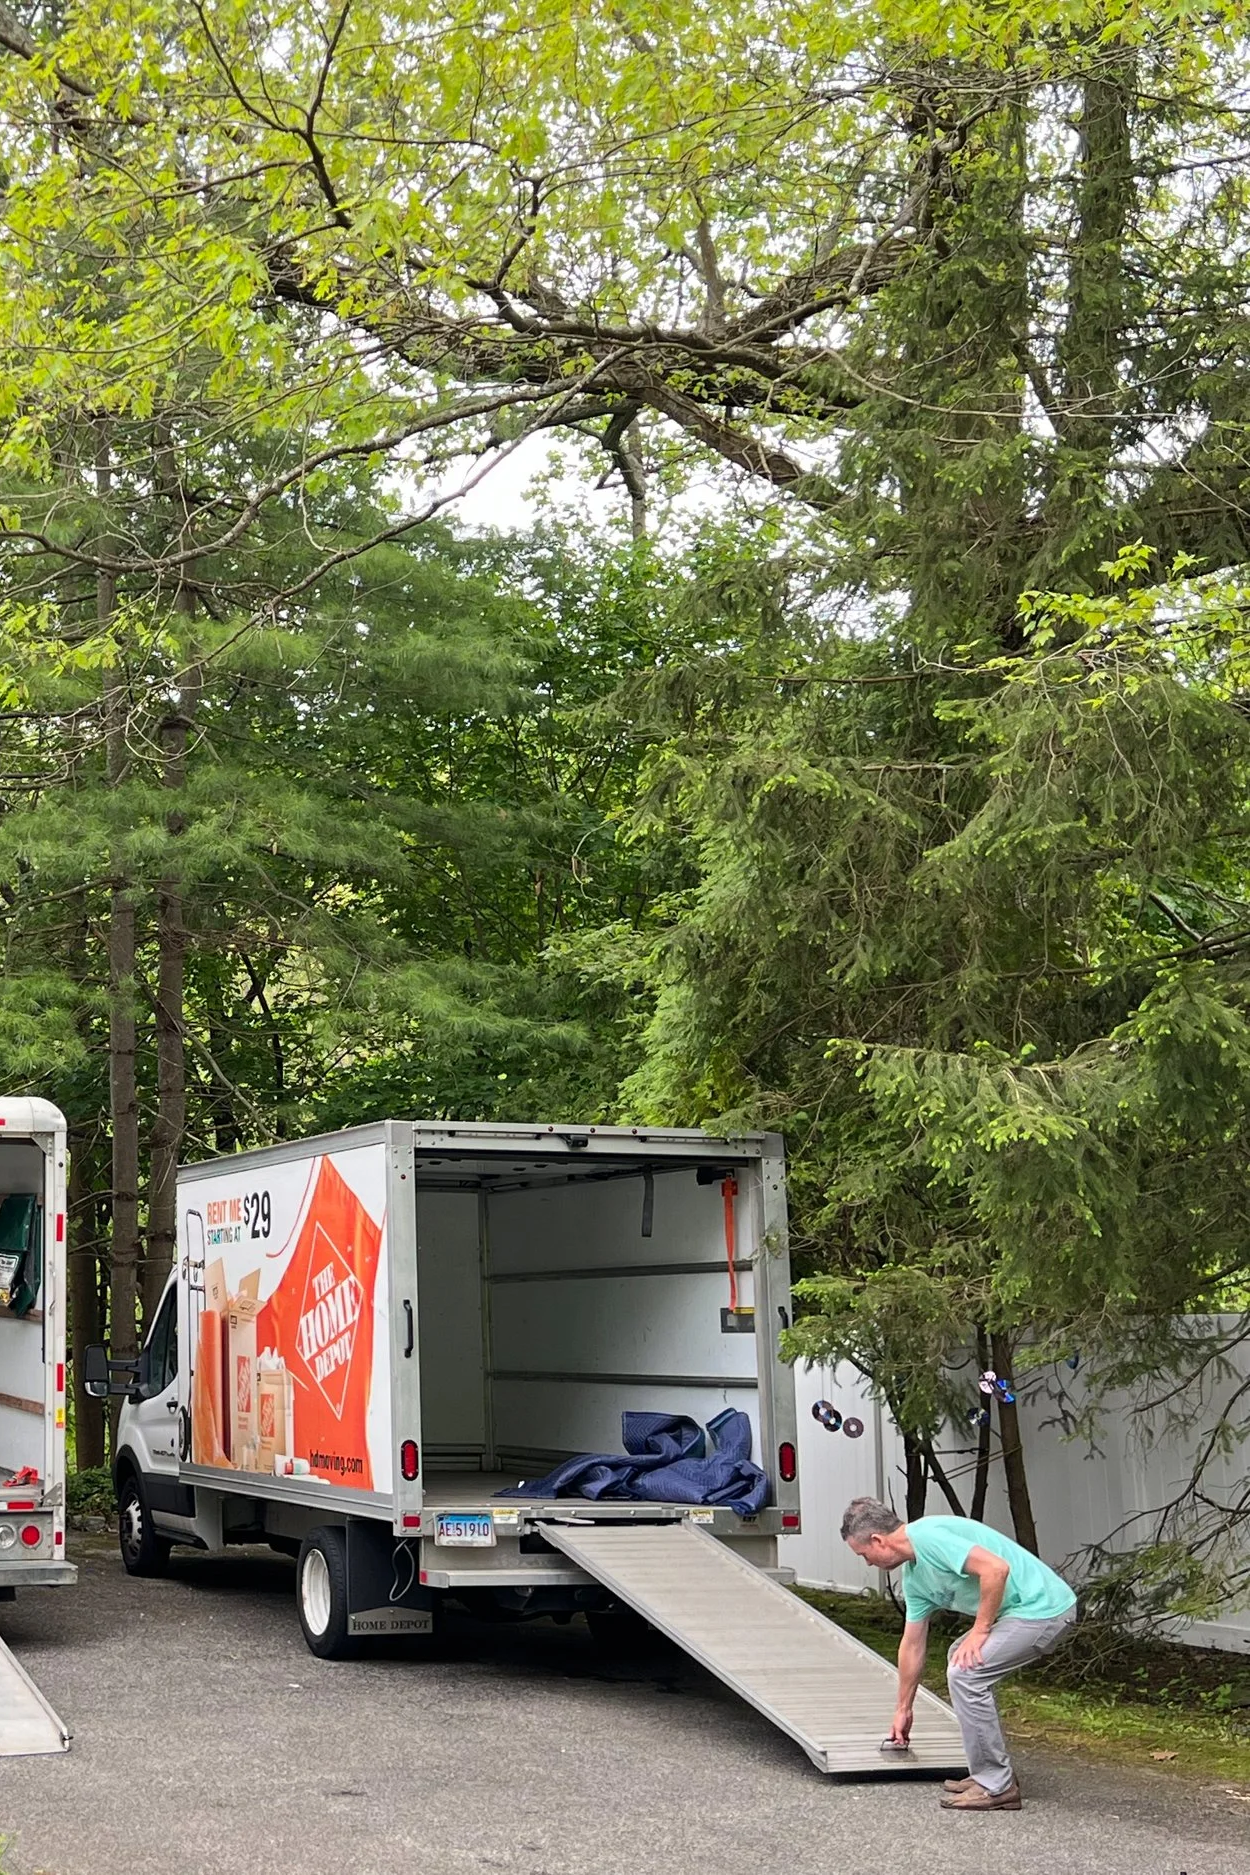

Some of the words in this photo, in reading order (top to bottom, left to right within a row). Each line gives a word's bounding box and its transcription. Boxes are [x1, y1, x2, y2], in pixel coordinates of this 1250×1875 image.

[207, 1200, 227, 1226] RENT
[229, 1197, 242, 1223] ME
[243, 1190, 271, 1240] $29
[207, 1226, 233, 1246] STARTING
[234, 1225, 241, 1243] AT
[311, 1261, 336, 1301] THE
[300, 1274, 359, 1361] HOME
[314, 1330, 352, 1384] DEPOT
[309, 1449, 363, 1477] hdmoving.com
[353, 1621, 386, 1630] HOME
[391, 1620, 429, 1629] DEPOT
